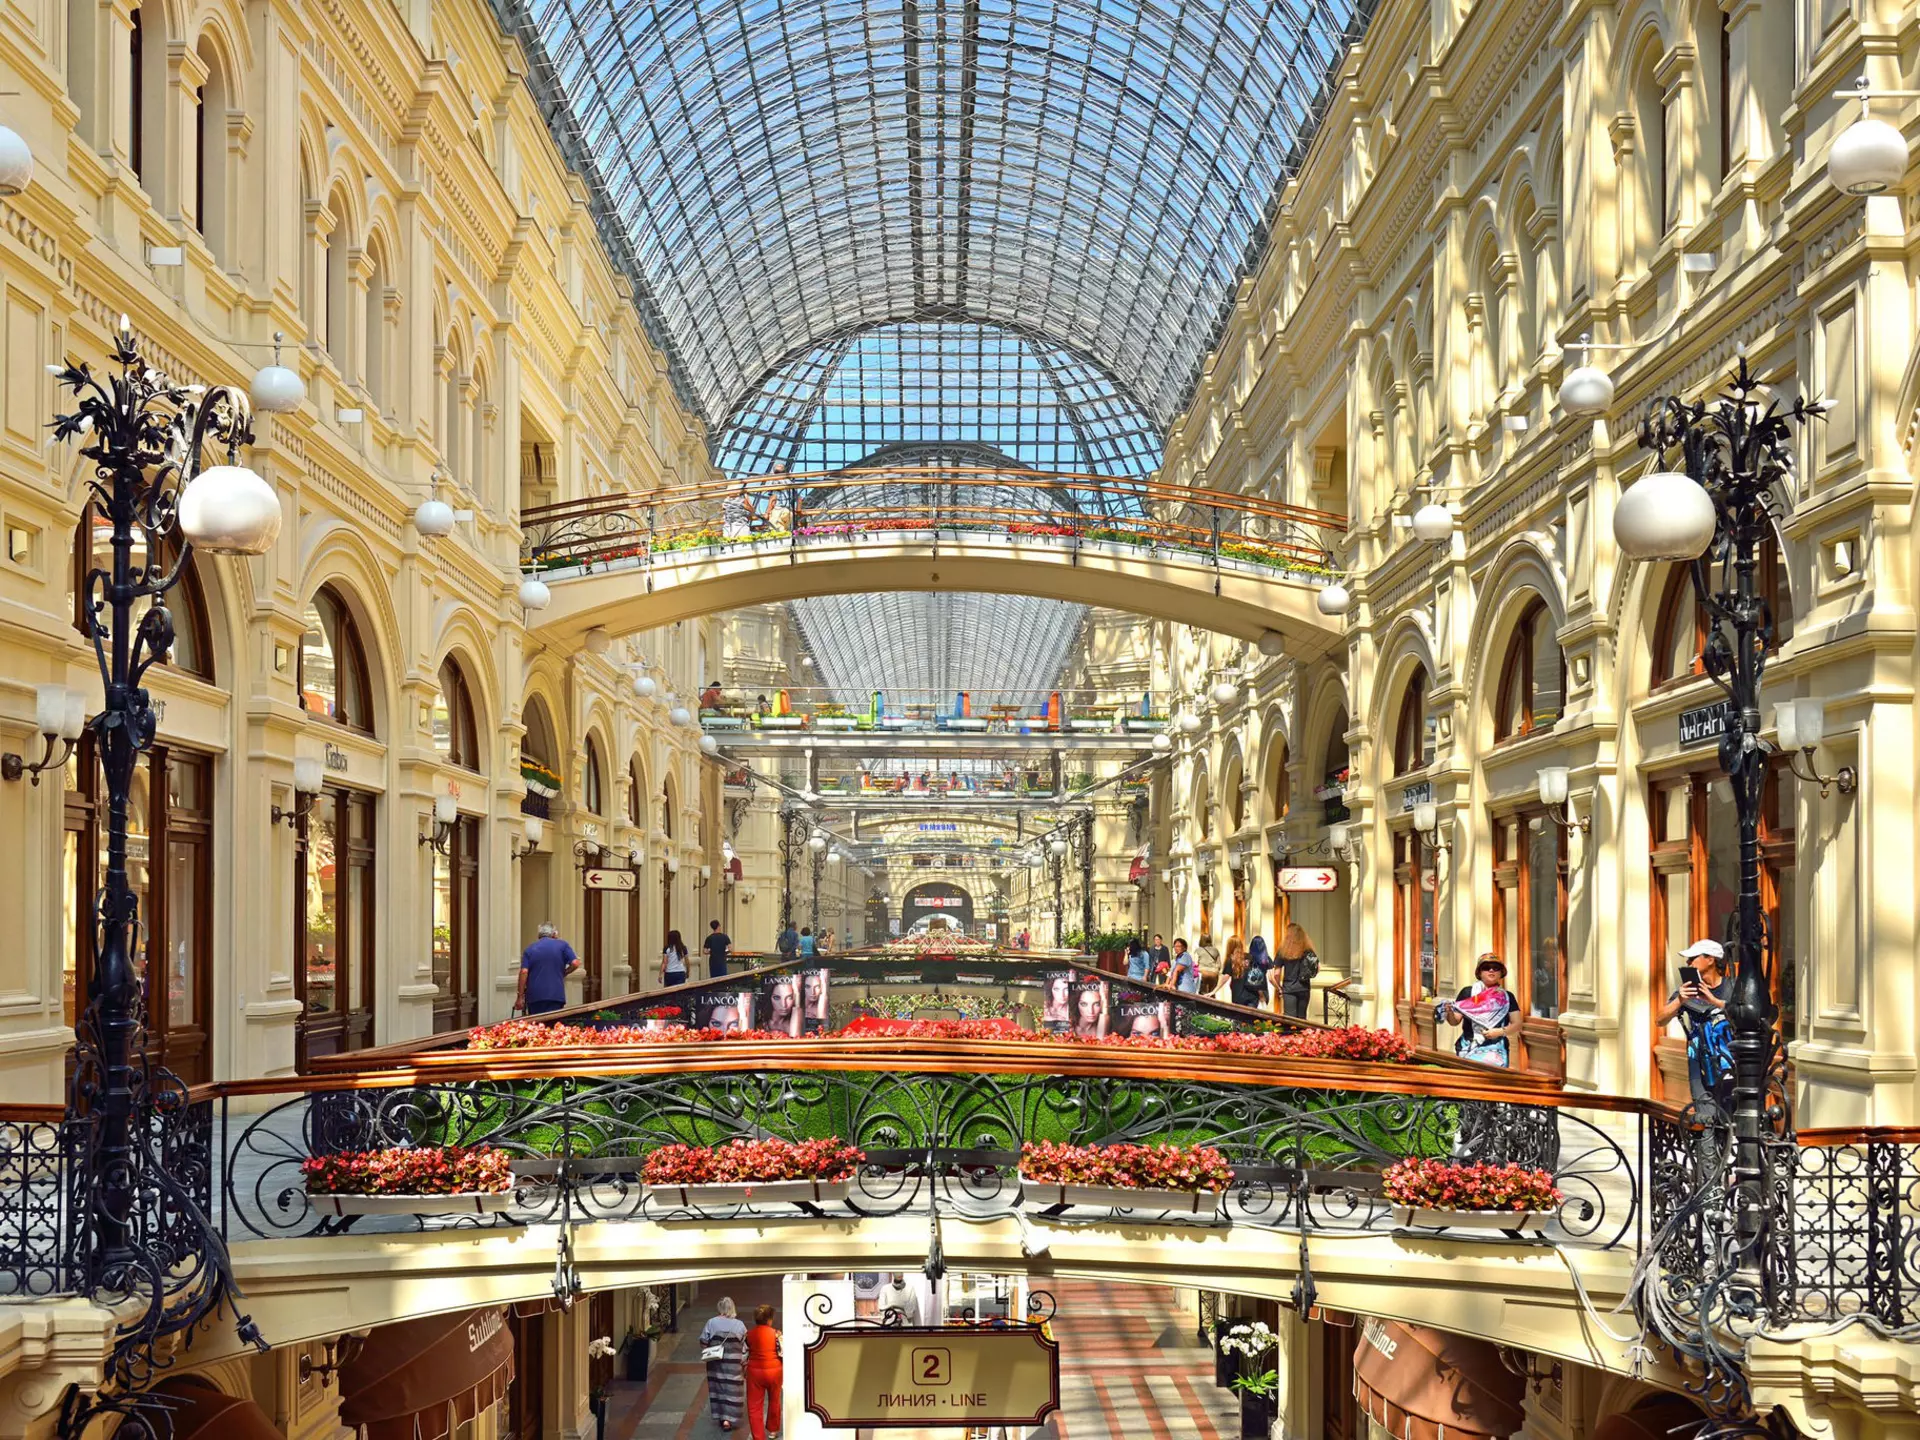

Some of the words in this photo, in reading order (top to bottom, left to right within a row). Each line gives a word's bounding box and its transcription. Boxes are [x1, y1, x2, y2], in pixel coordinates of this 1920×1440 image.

[468, 1310, 502, 1353] Sublime
[922, 1354, 940, 1378] 2
[877, 1393, 936, 1408] ЛИНИЯ
[950, 1393, 987, 1407] LINE
